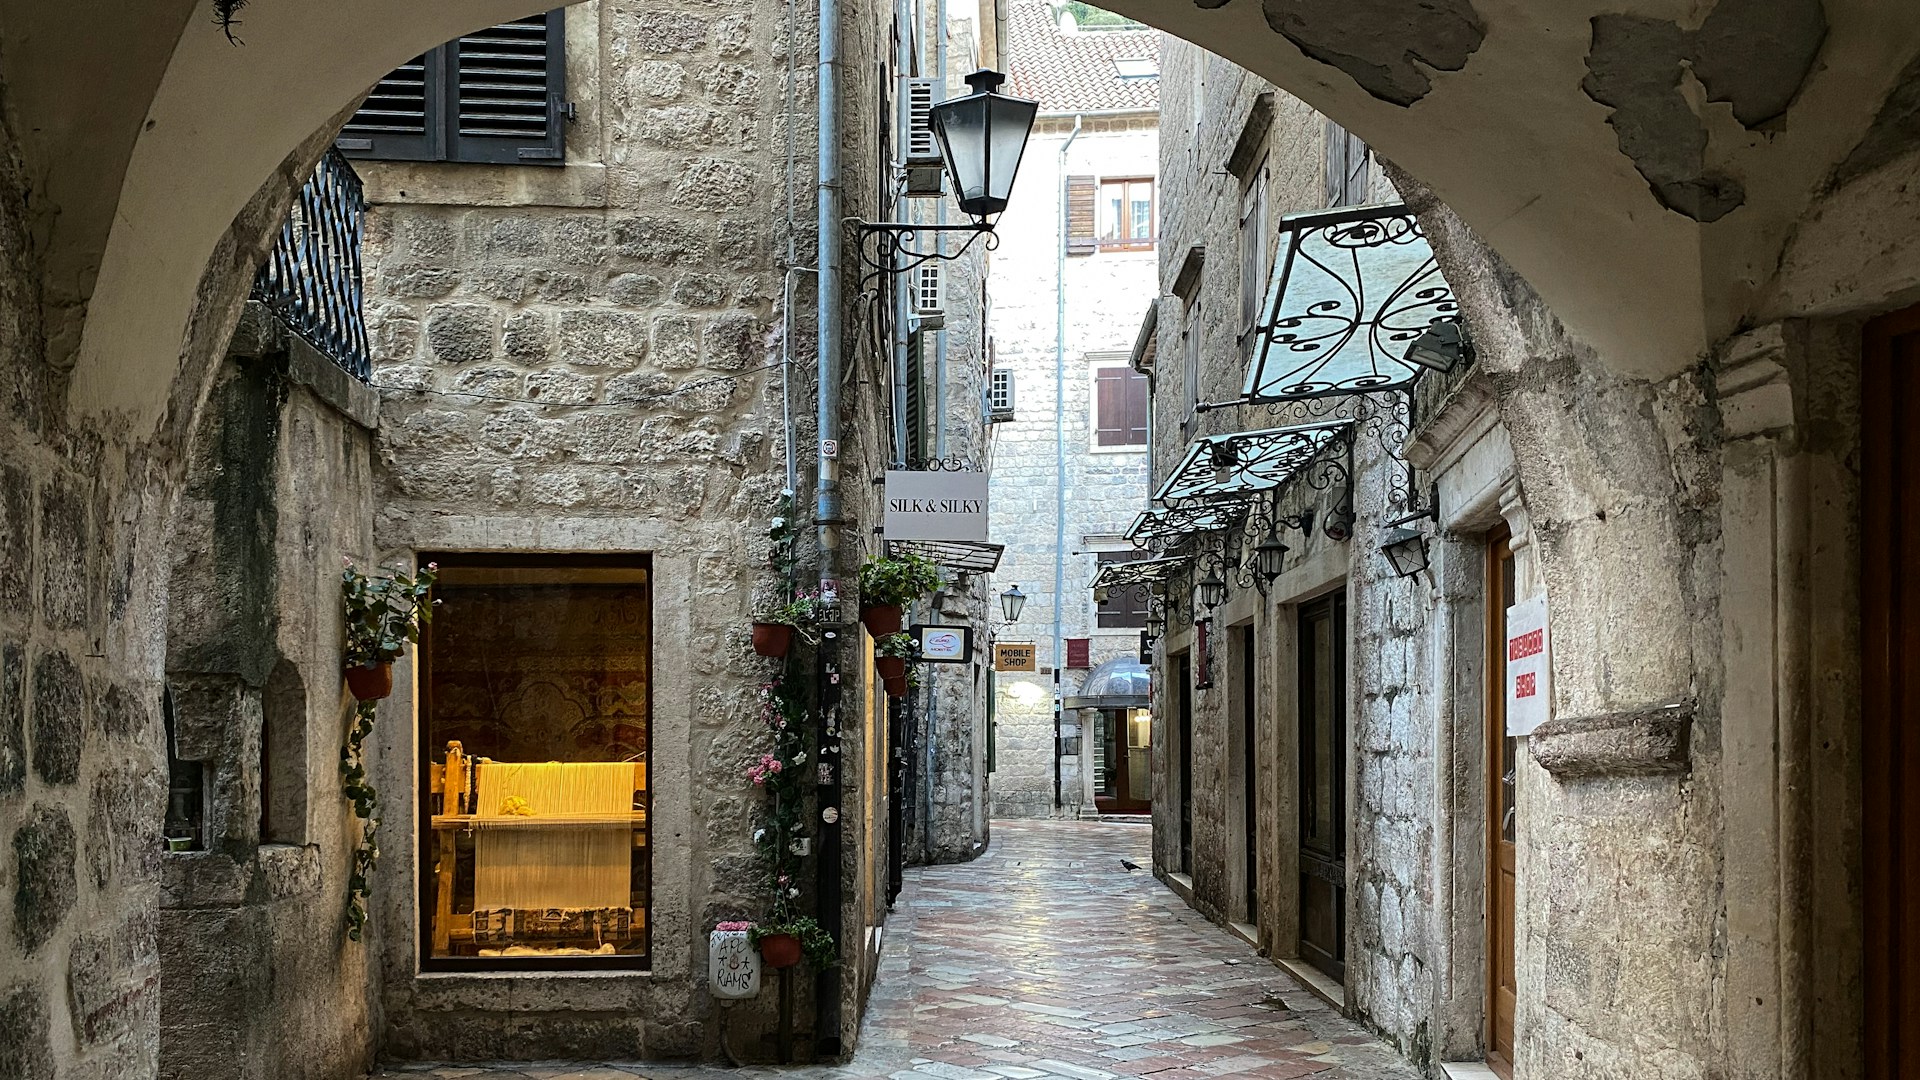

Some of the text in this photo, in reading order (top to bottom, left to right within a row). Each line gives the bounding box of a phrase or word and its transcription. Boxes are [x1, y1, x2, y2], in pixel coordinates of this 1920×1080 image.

[890, 499, 983, 514] SILK & SILKY
[1000, 649, 1031, 658] MOBILE
[1004, 658, 1027, 667] SHOP
